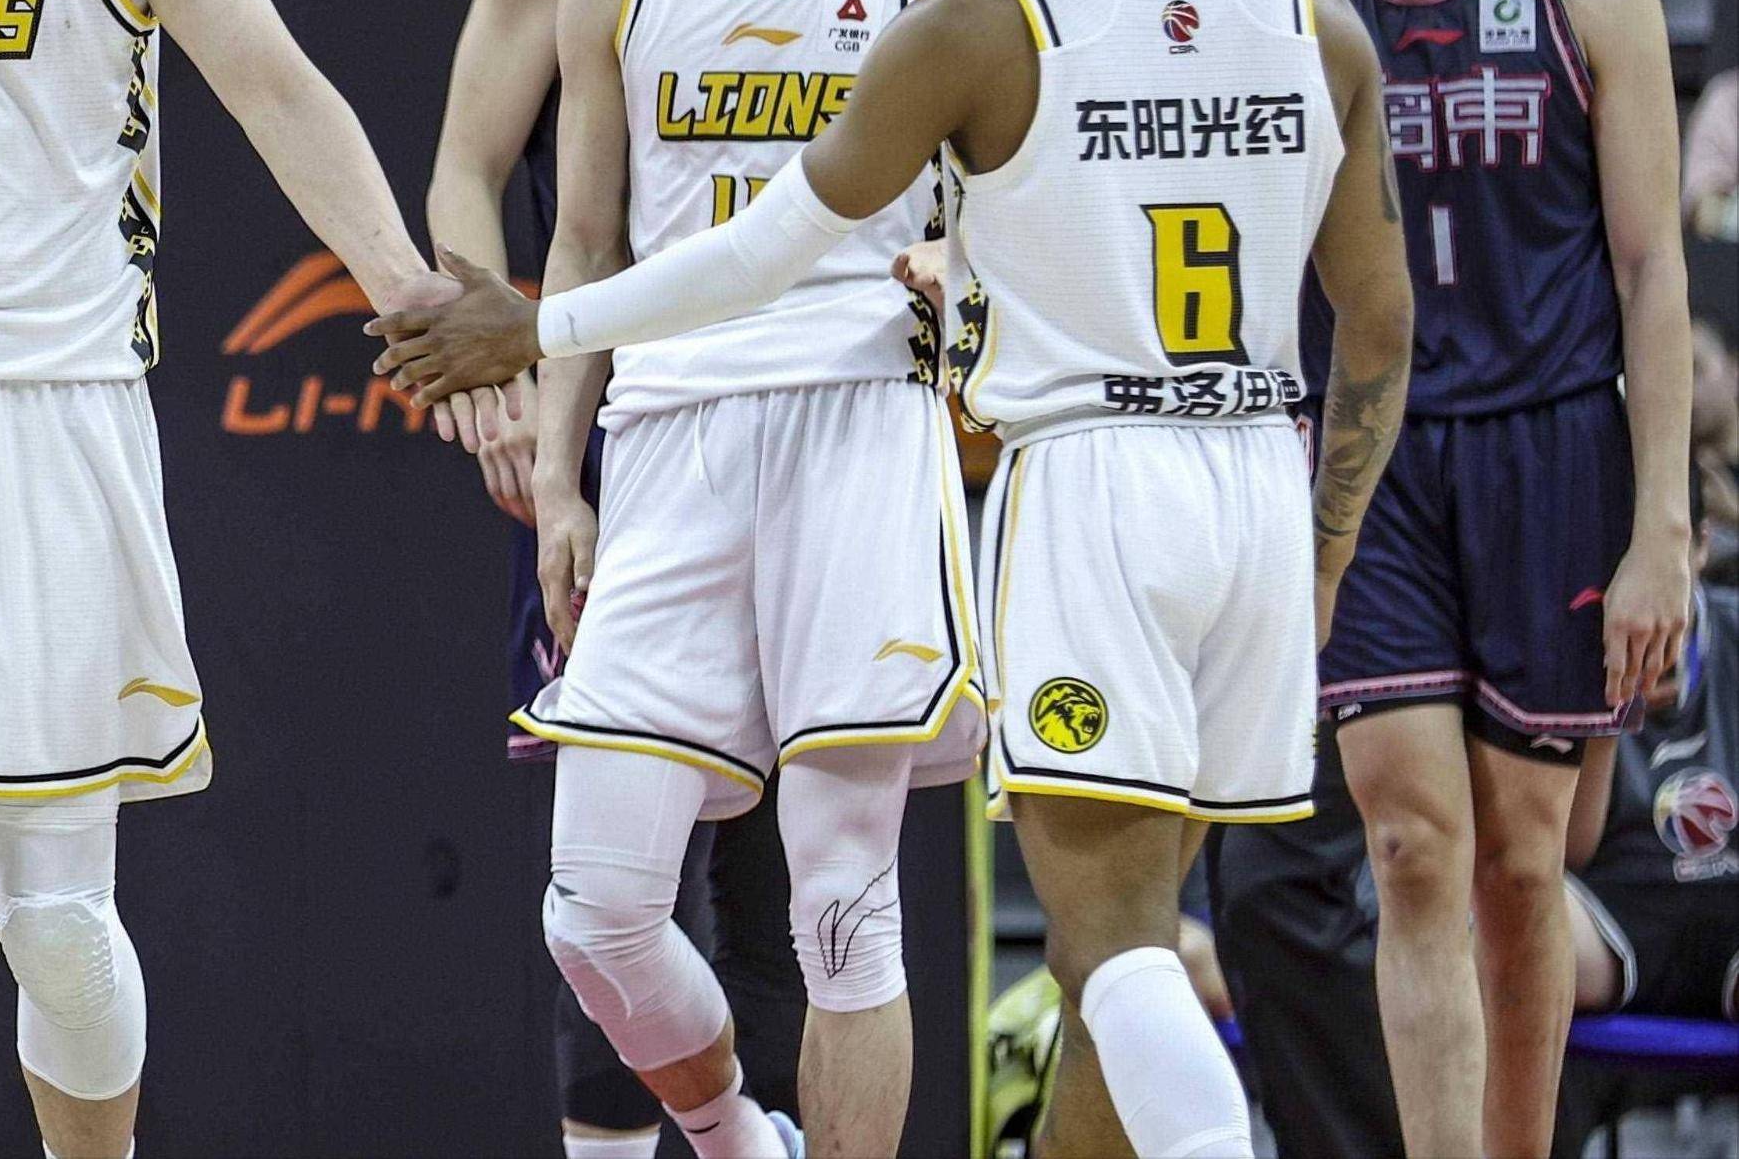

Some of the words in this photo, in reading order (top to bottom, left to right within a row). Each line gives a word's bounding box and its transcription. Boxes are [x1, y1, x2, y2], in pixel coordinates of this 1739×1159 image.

[1169, 44, 1199, 54] CBA
[657, 72, 860, 142] LIONS
[1075, 93, 1306, 161] 东阳光药
[711, 174, 771, 229] 1
[1429, 203, 1458, 287] 1
[1138, 202, 1252, 368] 6
